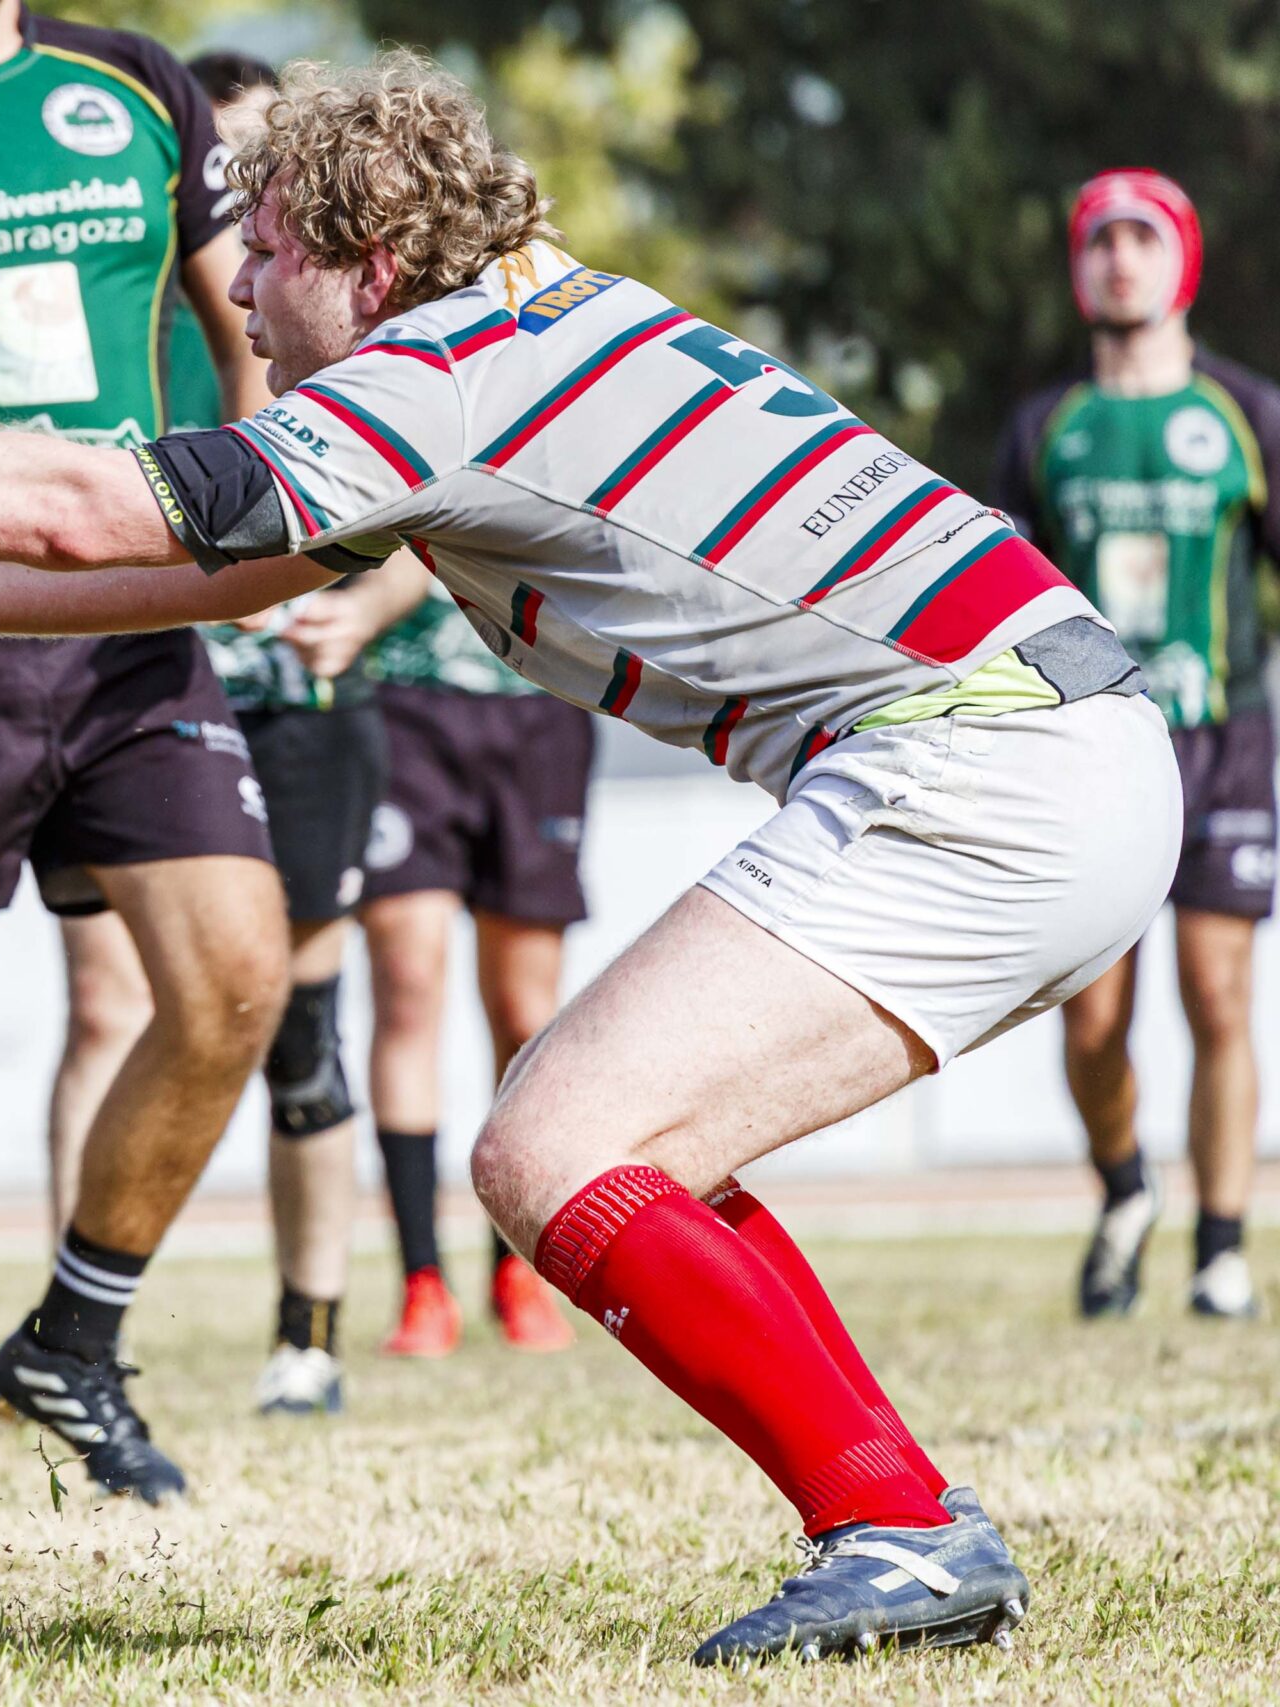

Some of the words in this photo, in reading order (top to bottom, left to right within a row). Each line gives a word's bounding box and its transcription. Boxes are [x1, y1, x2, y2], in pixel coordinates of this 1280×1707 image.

[666, 325, 839, 418] 5
[136, 448, 184, 525] OFFLOAD
[736, 857, 773, 888] KIPSTA
